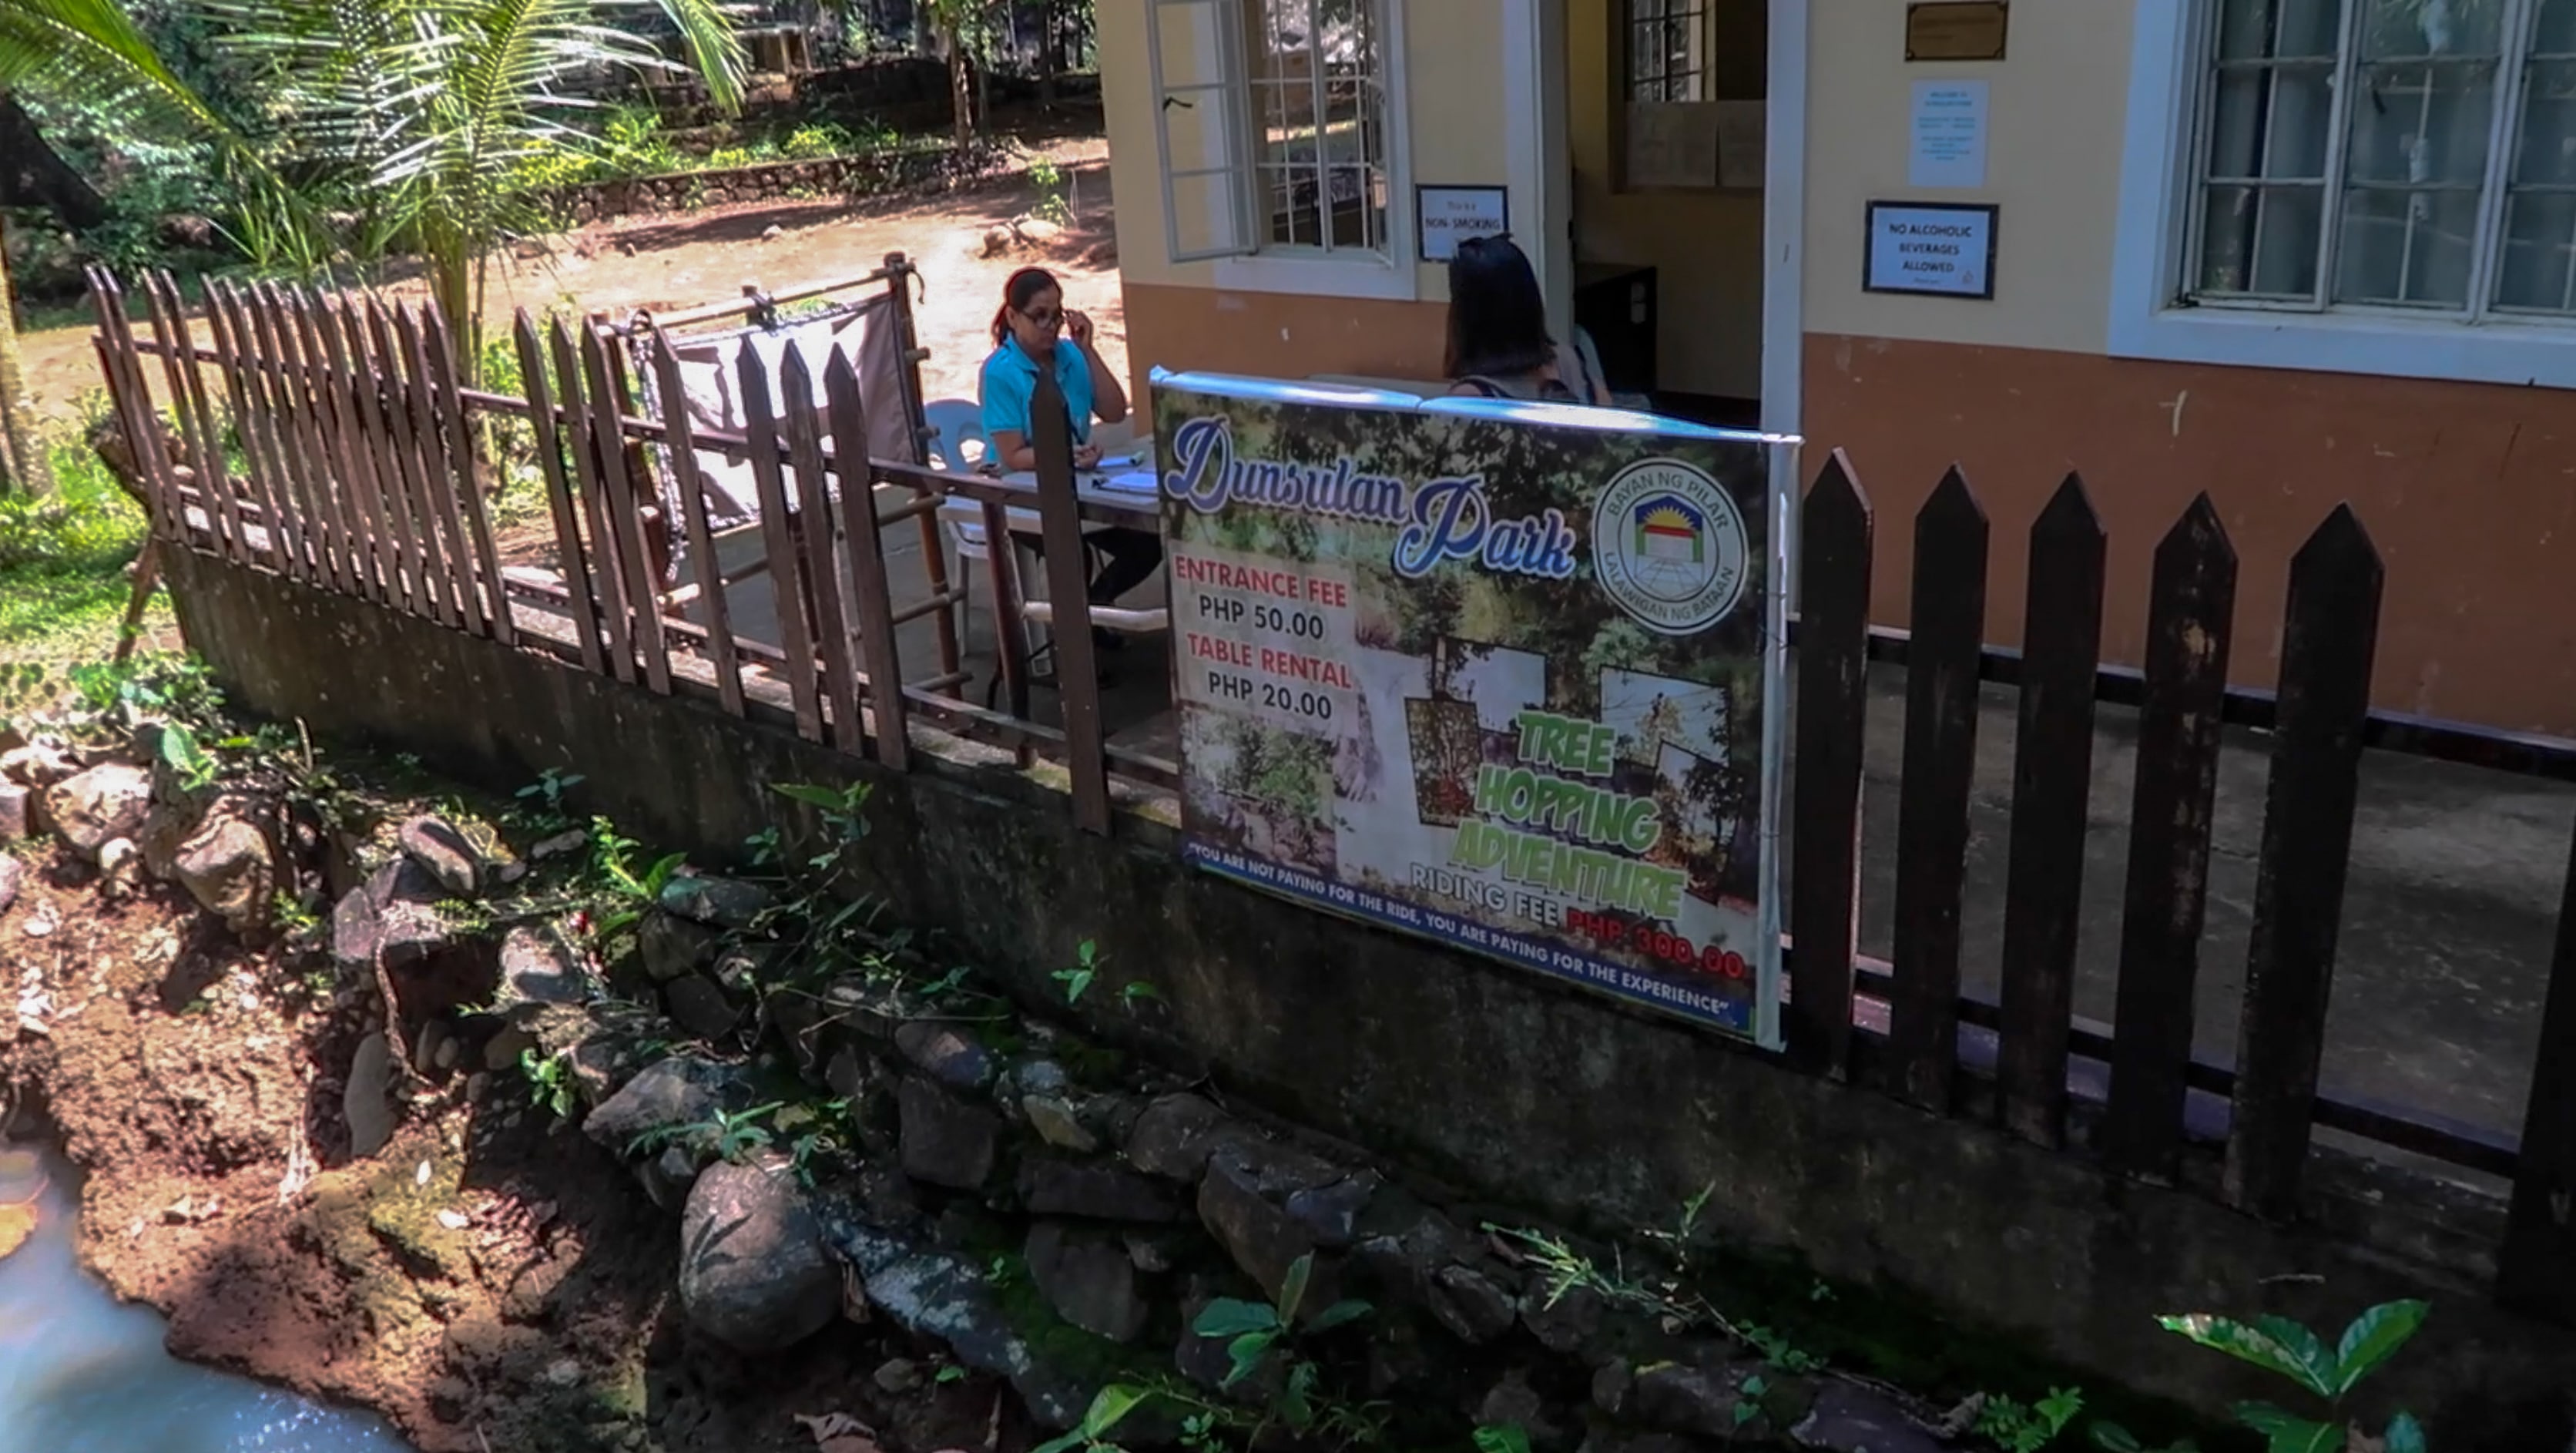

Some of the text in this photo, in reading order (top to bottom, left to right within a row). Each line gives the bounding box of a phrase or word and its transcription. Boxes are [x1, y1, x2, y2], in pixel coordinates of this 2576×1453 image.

[1890, 223, 1973, 237] NO ALCOHOLIC
[1899, 243, 1961, 256] BEVERAGES
[1903, 260, 1955, 273] ALLOWED
[1165, 414, 1576, 578] Dunsulan Park
[1607, 472, 1729, 529] BAYAN NG PILAR
[1175, 555, 1347, 608] ENTRANCE FEE
[1605, 552, 1734, 621] LALAWIGAN NG BATAAN
[1199, 595, 1324, 639] PHP 50.00
[1187, 633, 1352, 689] TABLE RENTAL
[1209, 672, 1332, 720] PHP 20.00
[1517, 710, 1616, 777] TREE
[1474, 763, 1662, 854] HOPPING
[1448, 818, 1688, 921] ADVENTURE
[1223, 853, 1245, 871] ARE
[1248, 860, 1275, 878] NOT
[1277, 869, 1326, 894] PAYING
[1329, 884, 1356, 904] FOR
[1359, 893, 1384, 911] THE
[1387, 902, 1422, 925] RIDE,
[1426, 913, 1456, 934] YOU
[1461, 925, 1488, 944] ARE
[1491, 933, 1548, 962] PAYING
[1553, 951, 1584, 975] FOR
[1588, 961, 1617, 984] THE
[1622, 971, 1729, 1015] EXPERIENCE"
[1410, 863, 1746, 980] RIDING FEE PHP 300.00
